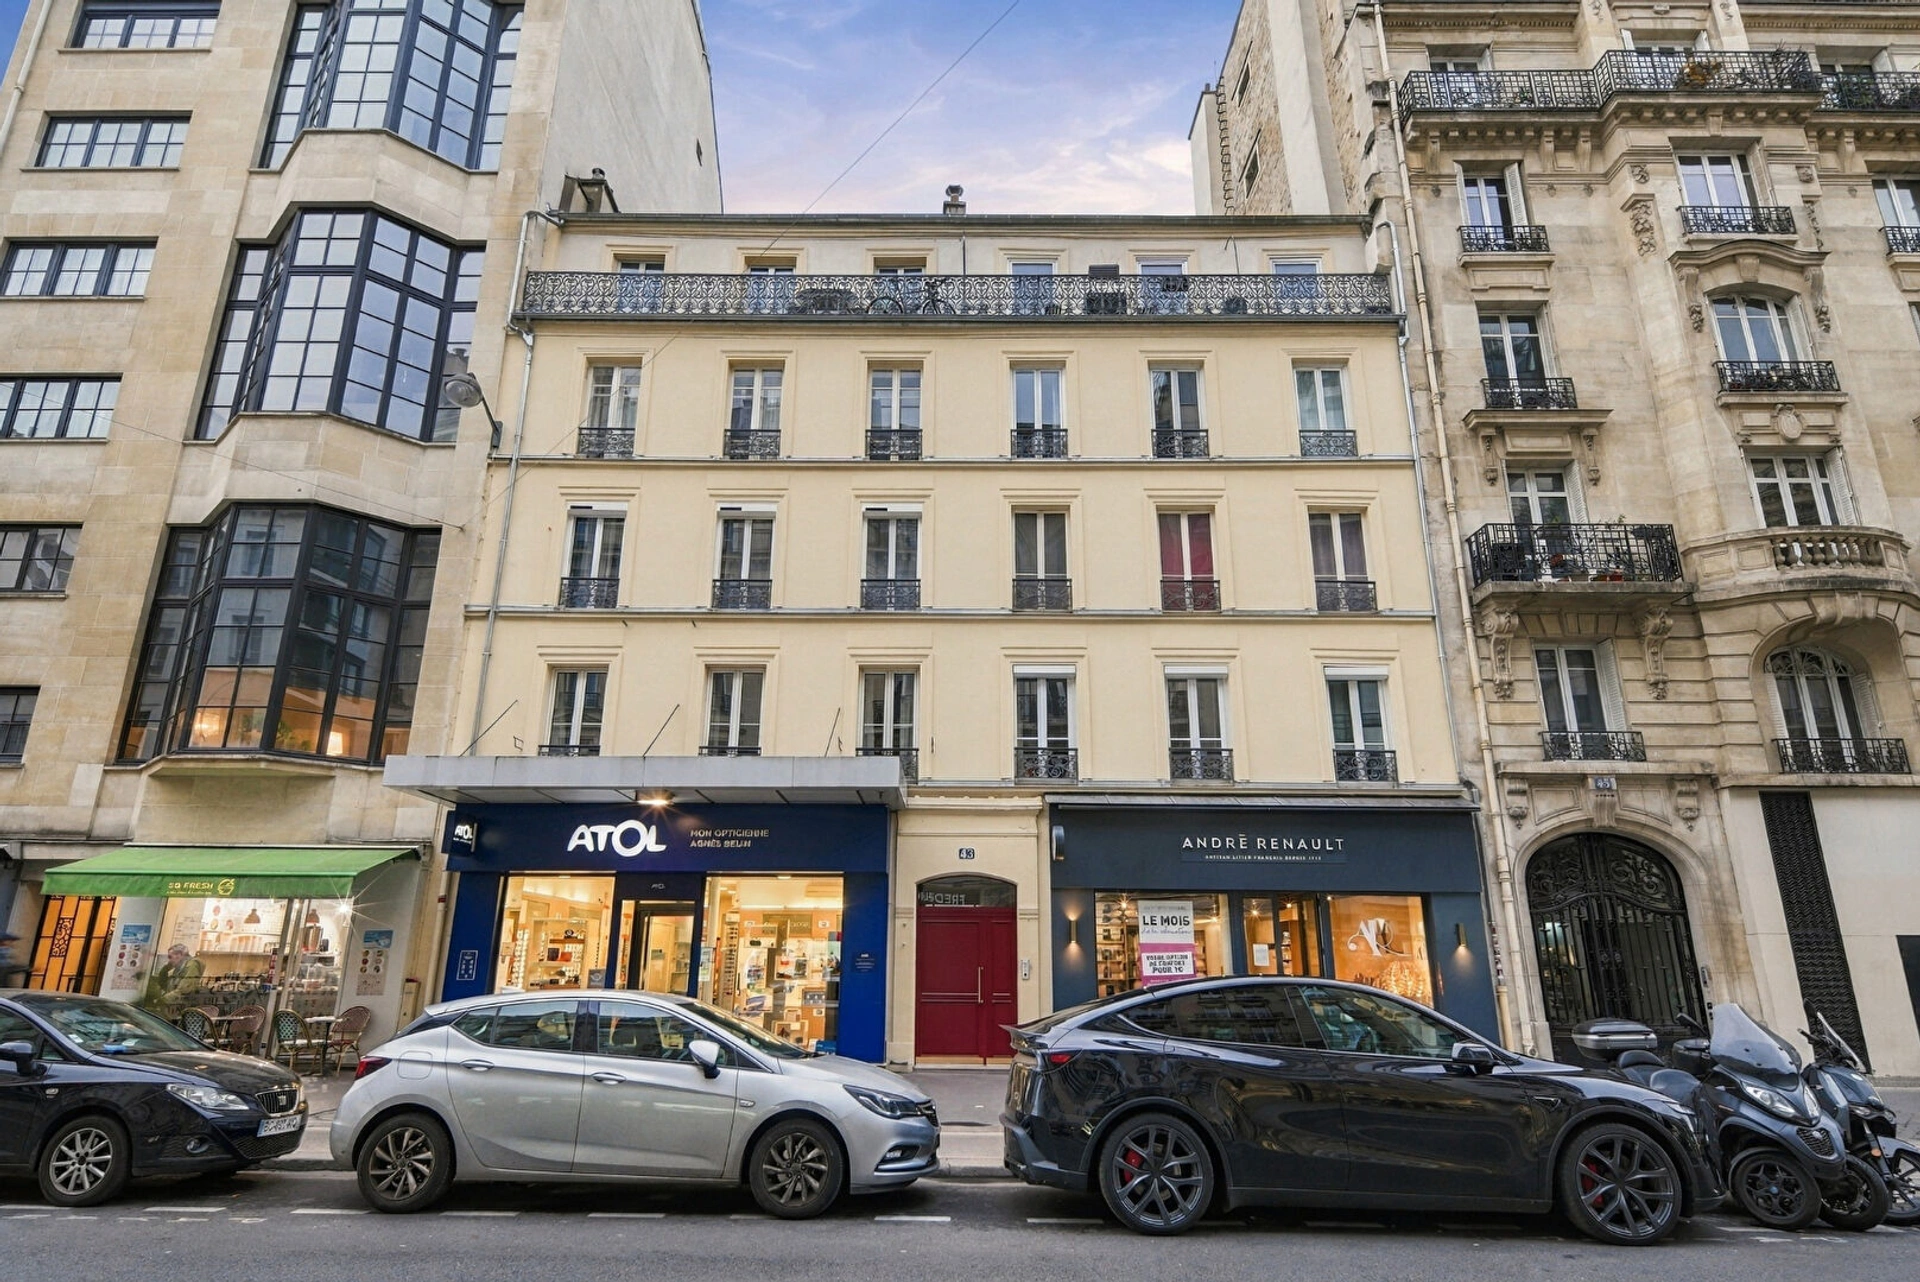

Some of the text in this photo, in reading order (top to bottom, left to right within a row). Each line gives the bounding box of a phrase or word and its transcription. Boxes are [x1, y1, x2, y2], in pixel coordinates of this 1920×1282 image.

[567, 819, 667, 857] ATOL
[690, 829, 712, 837] MON
[1257, 837, 1344, 850] RENAULT
[959, 848, 974, 859] 43
[1142, 915, 1190, 926] LE MOIS
